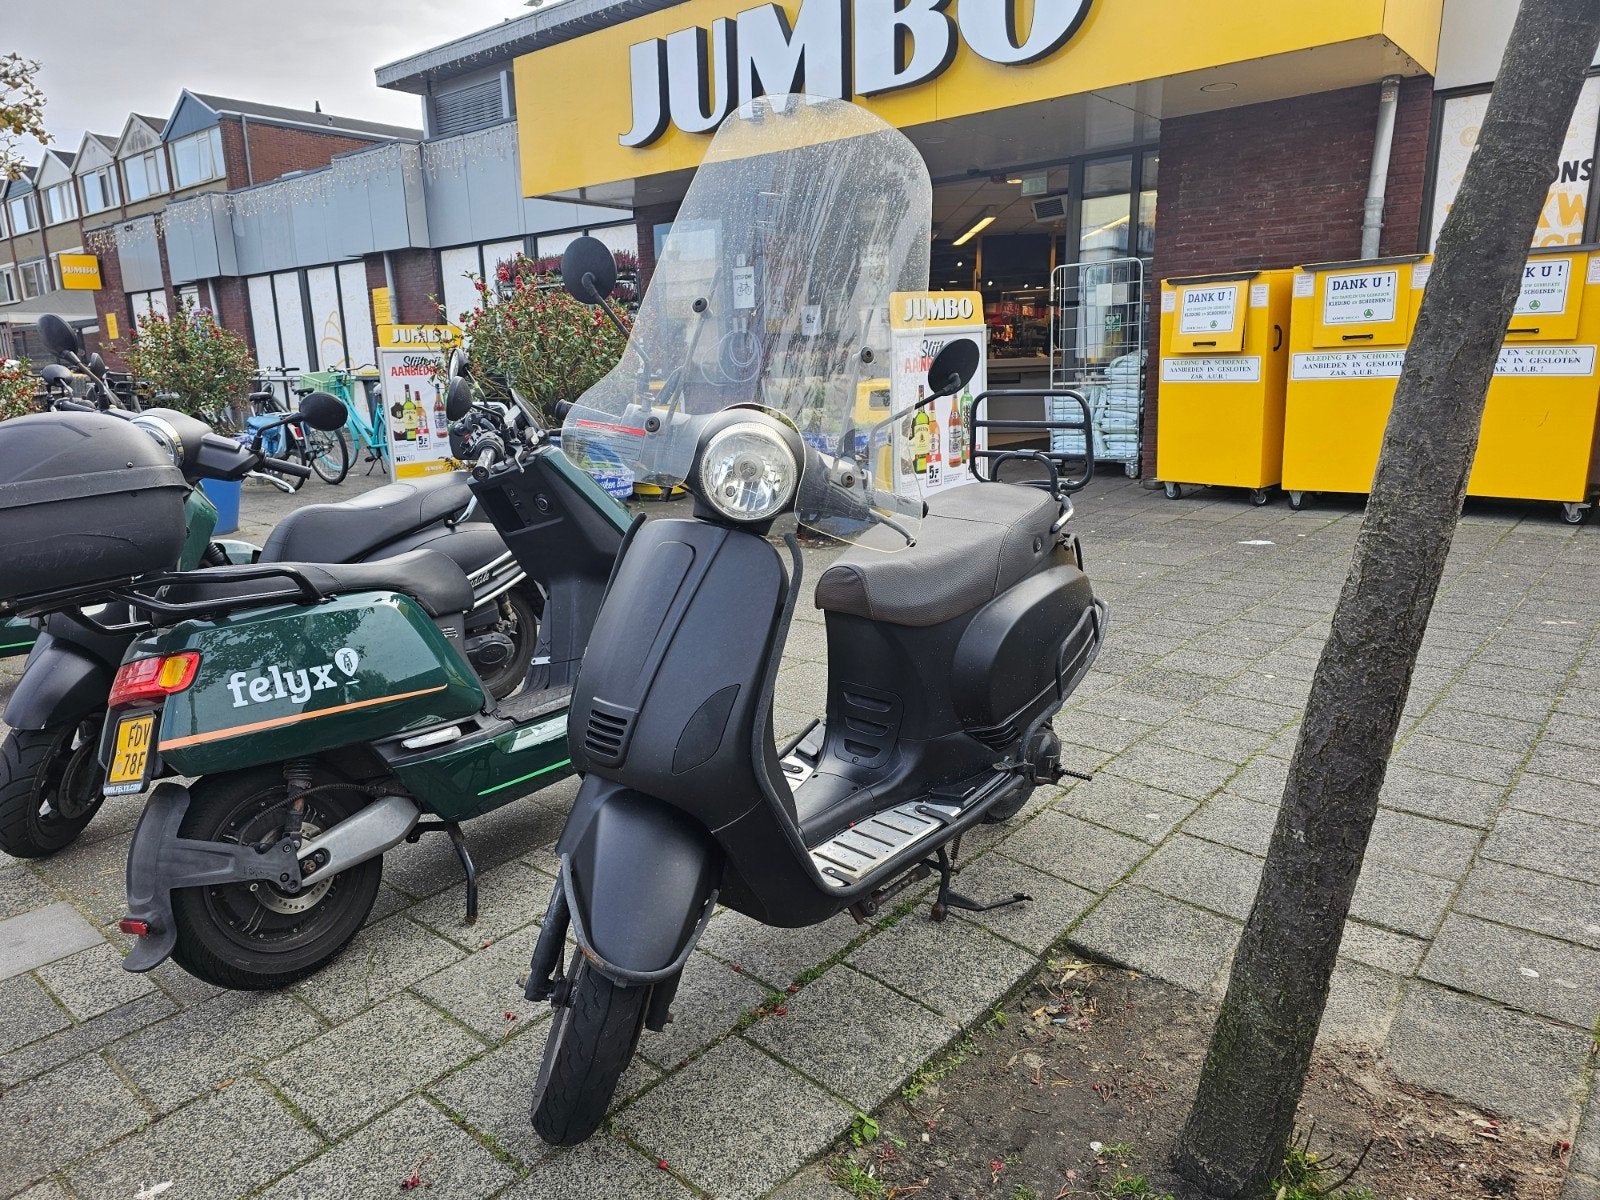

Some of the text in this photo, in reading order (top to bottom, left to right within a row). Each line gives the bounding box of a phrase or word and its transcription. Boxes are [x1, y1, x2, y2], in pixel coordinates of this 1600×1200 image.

[1332, 278, 1368, 291] DANK
[1372, 277, 1382, 287] U
[1188, 292, 1214, 303] DANK
[1218, 292, 1226, 301] U
[904, 297, 973, 321] JUMBO
[1525, 348, 1578, 356] SCHOENEN
[1302, 362, 1347, 370] AANBIEDEN
[227, 664, 337, 708] felyx
[128, 722, 150, 748] FDV
[122, 752, 146, 775] 78F
